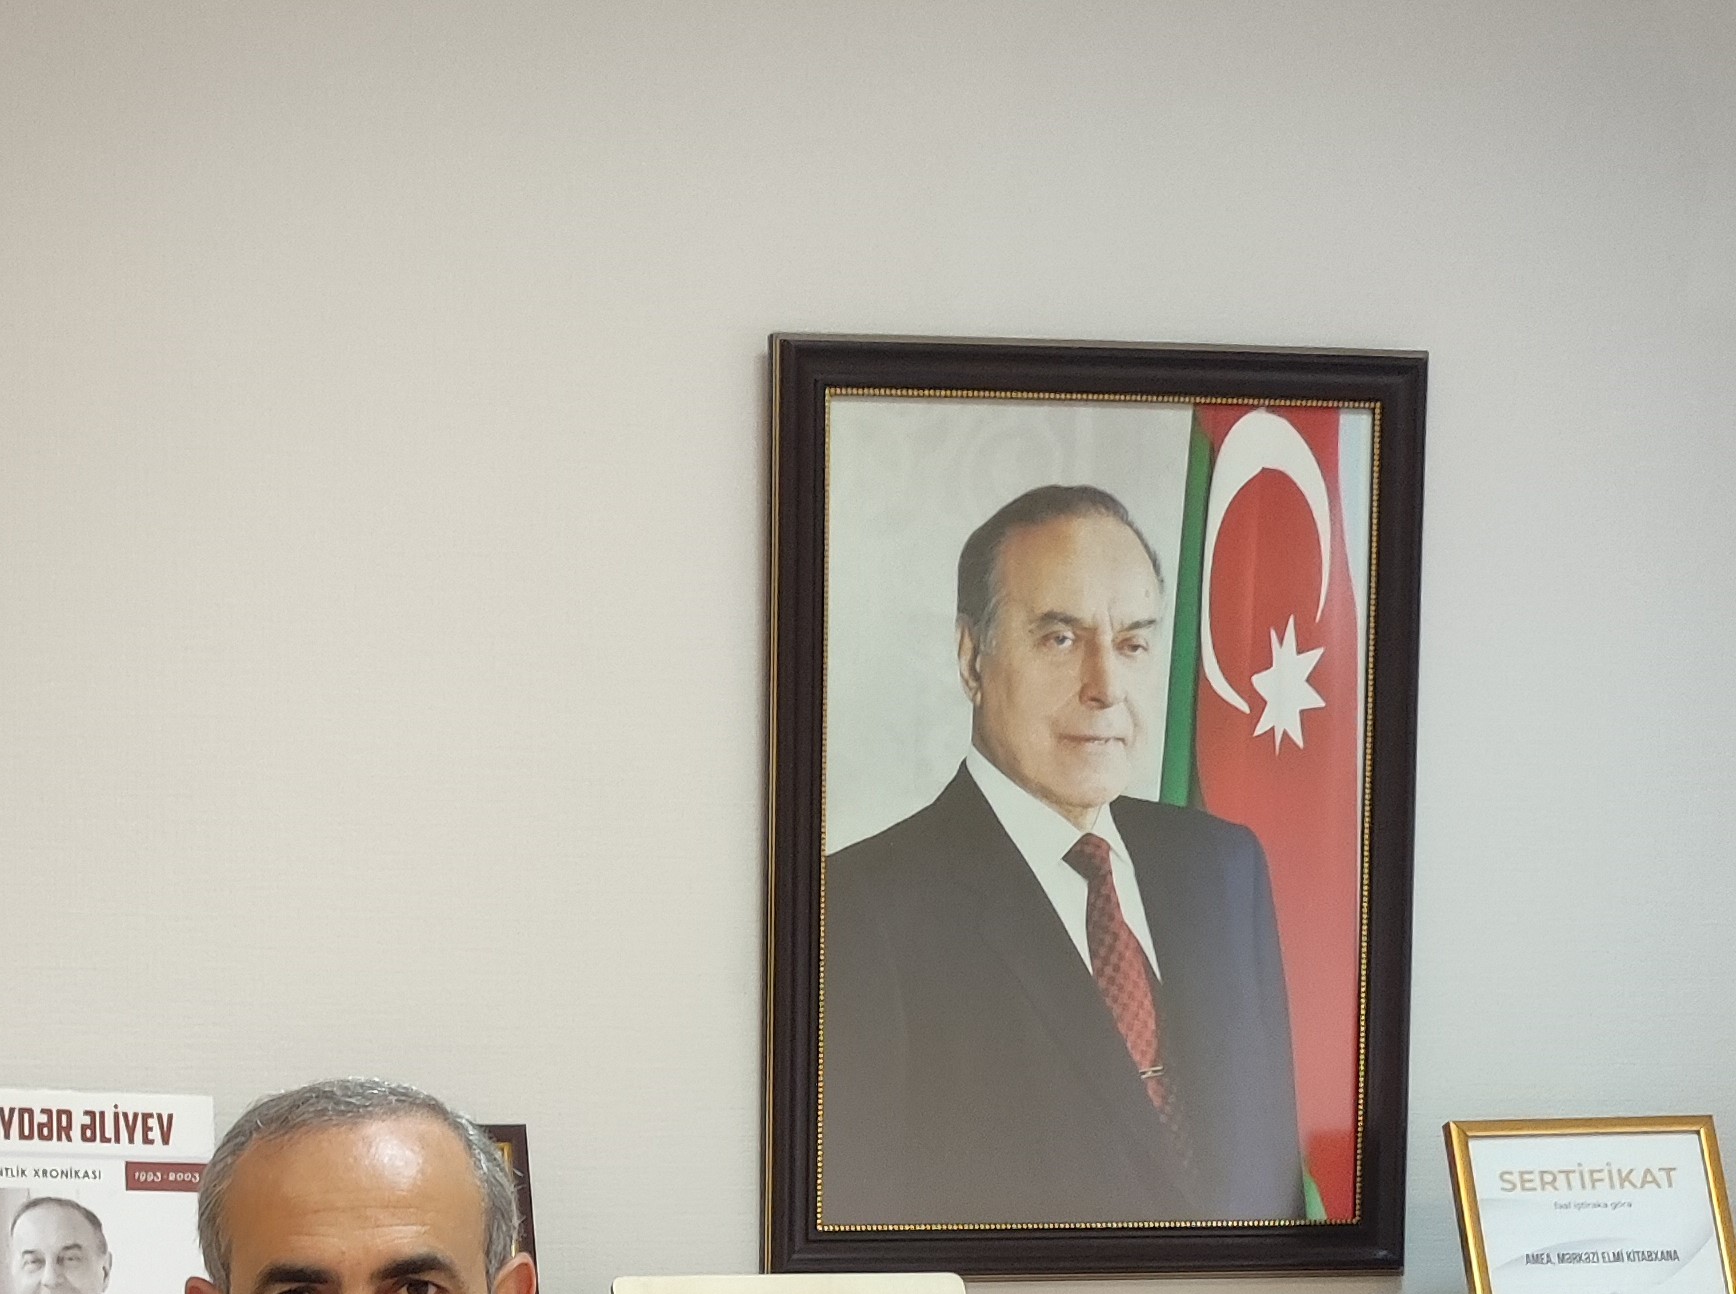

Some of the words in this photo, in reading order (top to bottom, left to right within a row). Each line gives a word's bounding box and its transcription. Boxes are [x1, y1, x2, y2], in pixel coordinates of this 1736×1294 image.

[81, 1104, 174, 1146] ƏLİYEV
[33, 1167, 102, 1180] XRONİKASI
[1499, 1162, 1677, 1192] SERTİFİKAT
